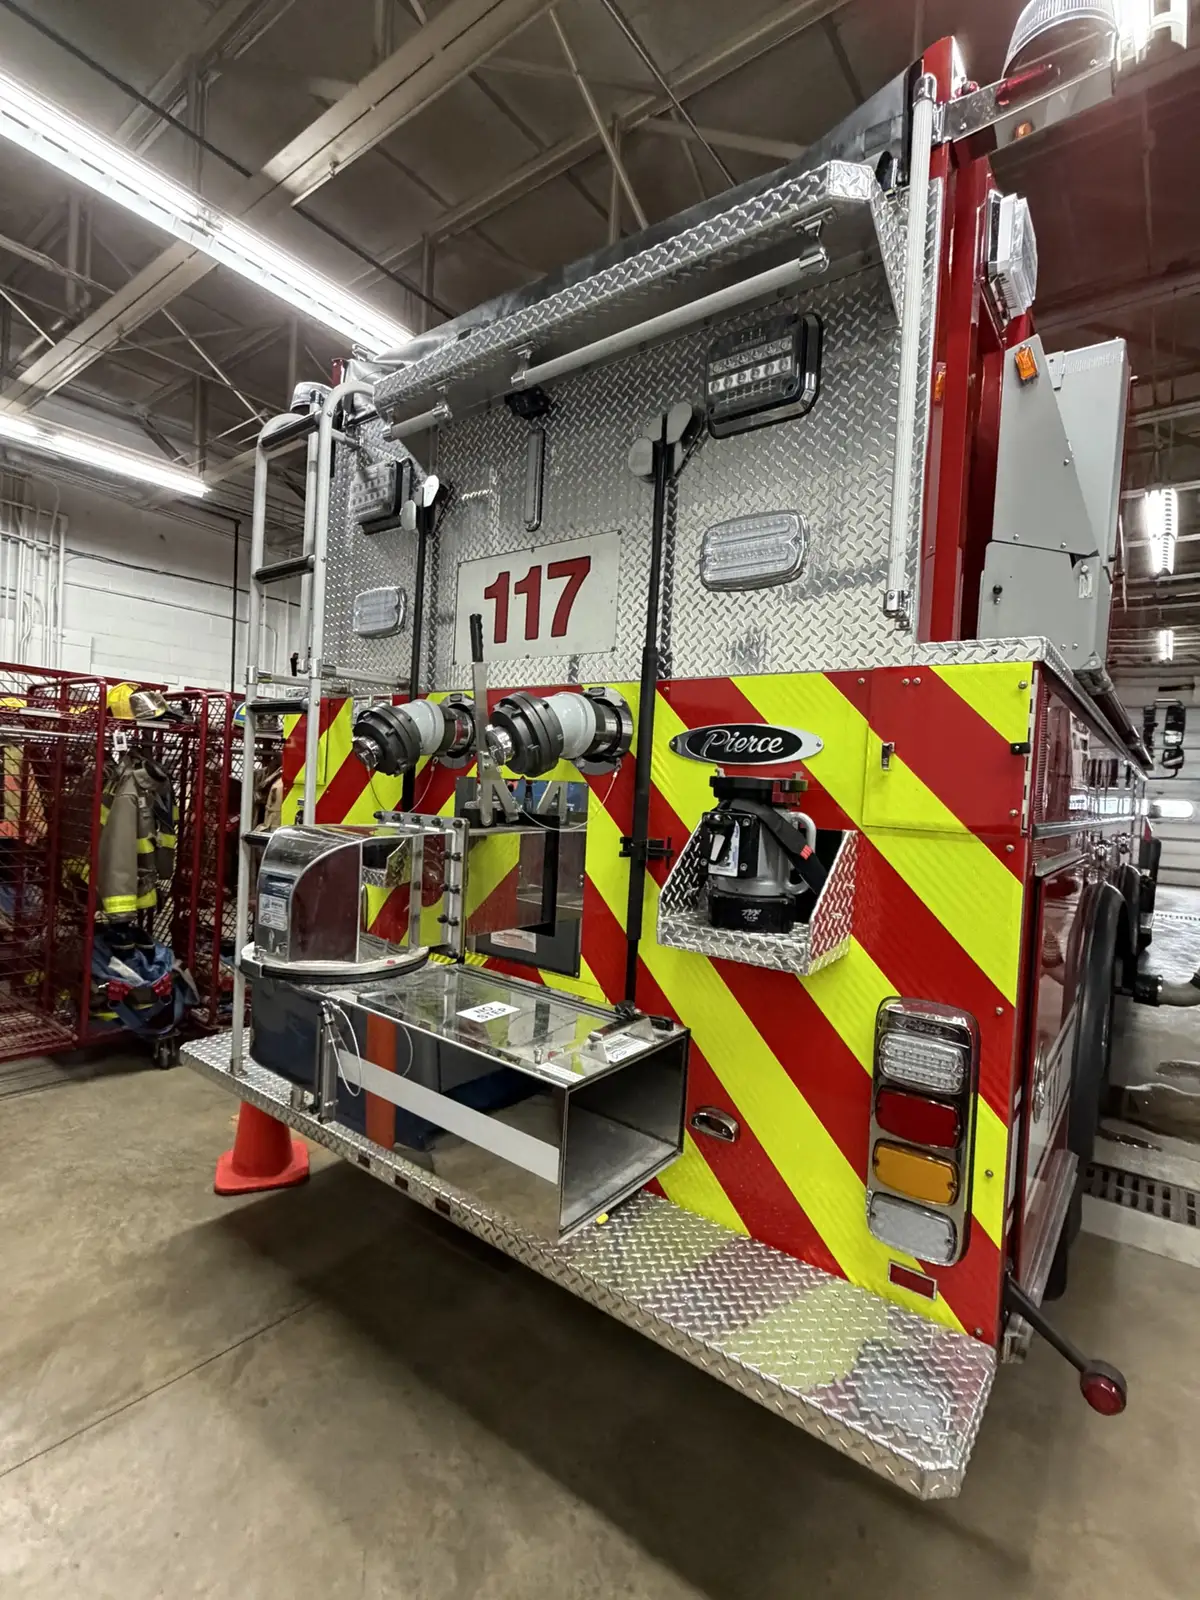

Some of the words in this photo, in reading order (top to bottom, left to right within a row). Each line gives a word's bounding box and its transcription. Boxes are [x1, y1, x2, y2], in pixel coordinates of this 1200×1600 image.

[484, 555, 591, 644] 117
[700, 729, 784, 757] Pierce
[474, 1006, 493, 1014] NO
[476, 1008, 506, 1019] STEP
